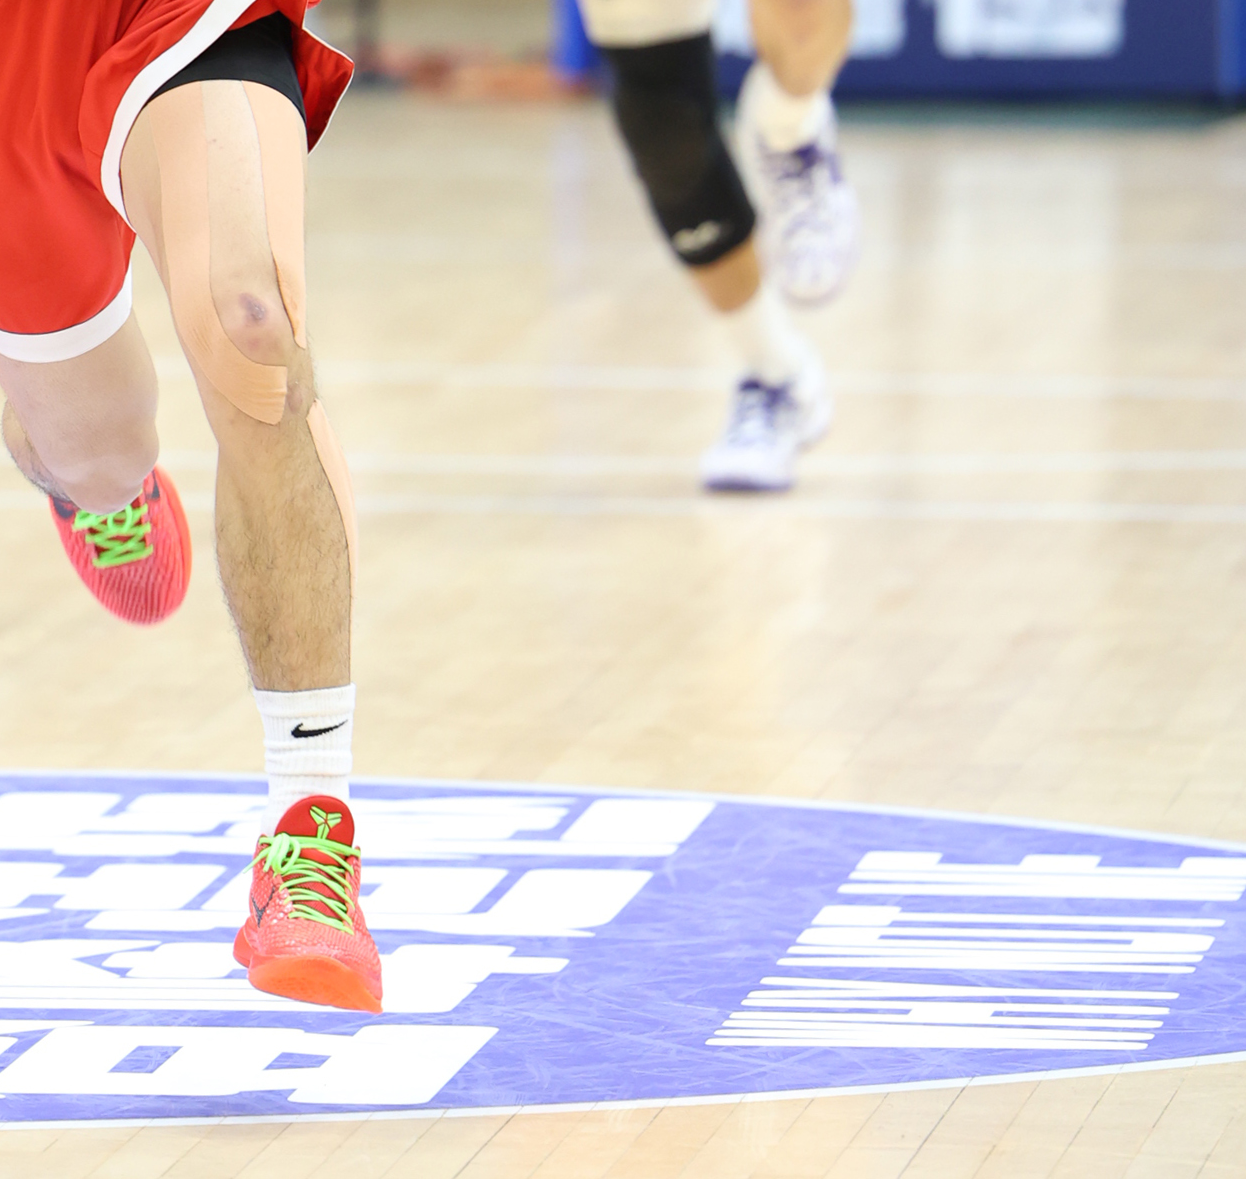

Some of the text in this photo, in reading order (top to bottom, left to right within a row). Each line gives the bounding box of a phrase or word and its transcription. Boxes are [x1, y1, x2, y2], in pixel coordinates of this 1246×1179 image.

[704, 850, 1246, 1051] WHY NOT ME
